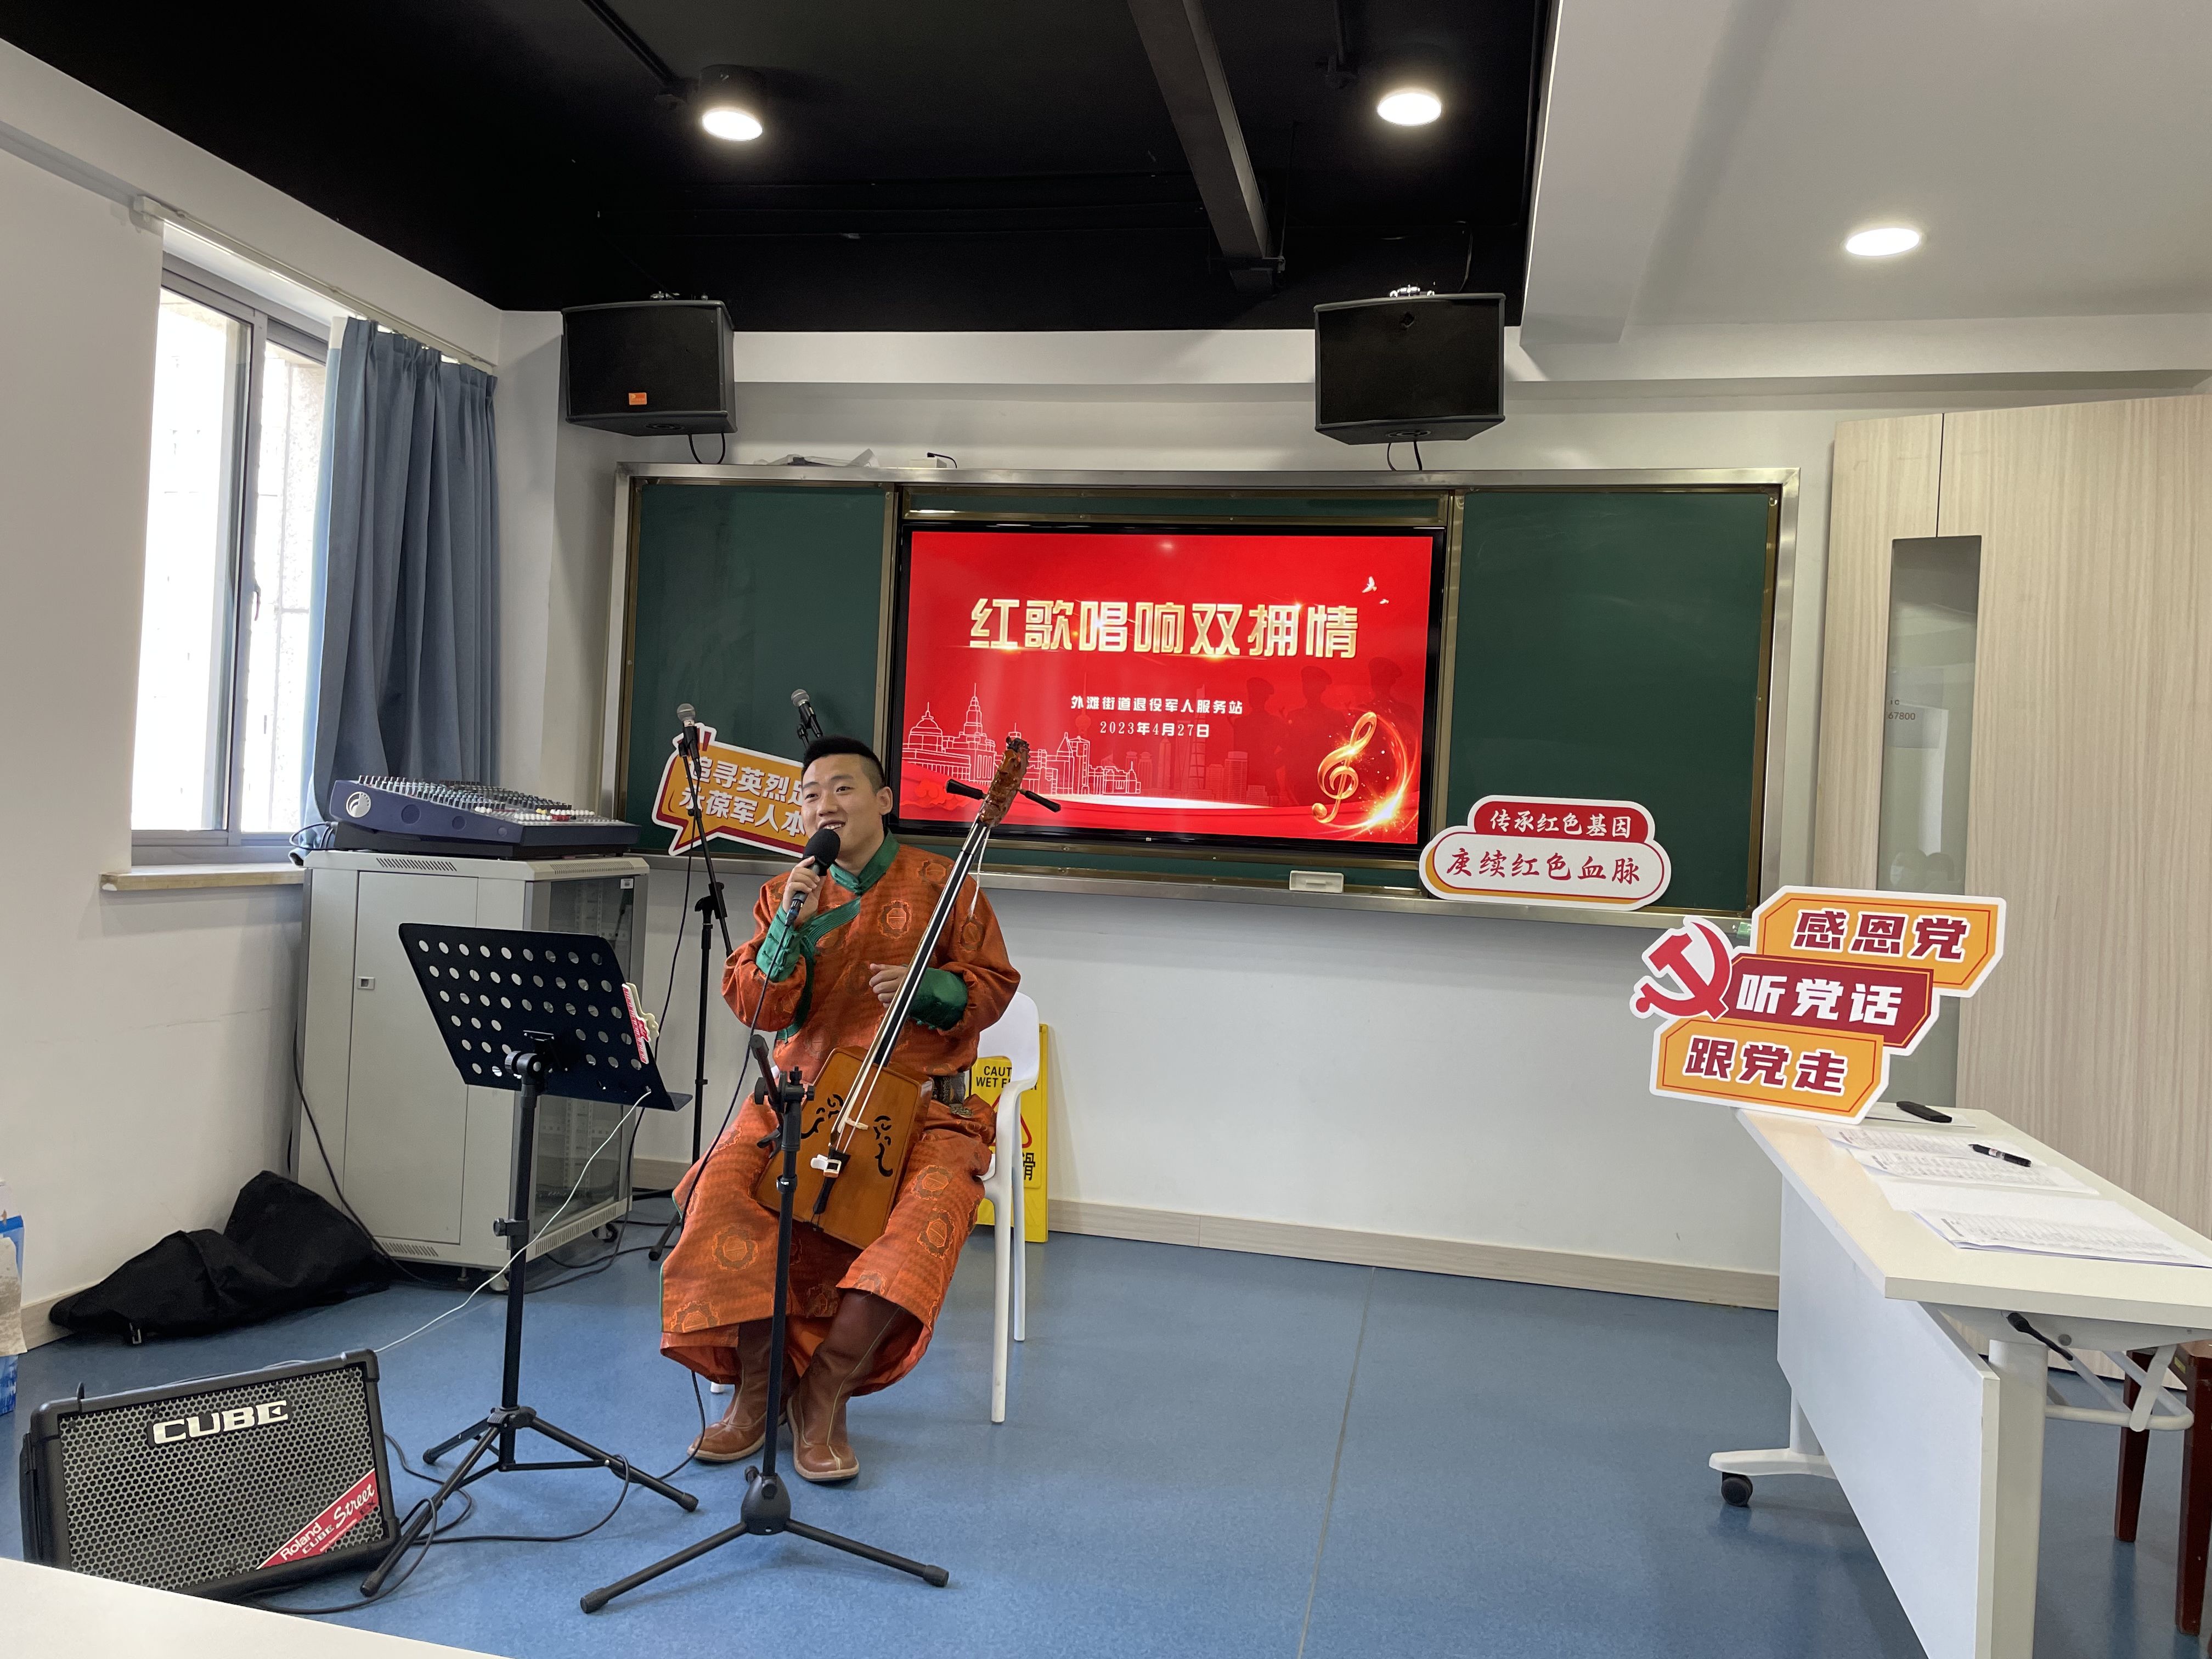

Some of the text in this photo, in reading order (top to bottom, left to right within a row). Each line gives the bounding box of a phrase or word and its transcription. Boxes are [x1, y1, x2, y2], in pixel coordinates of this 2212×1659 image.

[969, 597, 1359, 658] 红歌唱响双拥情
[1071, 695, 1243, 715] 外滩街道退役军人服务站
[1100, 720, 1210, 737] 2023年4月27日
[686, 756, 804, 807] 追寻英烈足
[679, 785, 806, 837] 永葆军人本
[1489, 809, 1632, 839] 传承红色基因
[1446, 848, 1640, 885] 庚续红色血脉
[1791, 910, 1970, 961] 感恩党
[1736, 974, 1903, 1026] 听党话
[976, 1077, 998, 1088] WET
[984, 1065, 1012, 1077] CAUT
[1684, 1036, 1849, 1094] 跟党走
[153, 1400, 288, 1445] CUBE
[280, 1521, 323, 1561] Roland
[302, 1523, 335, 1555] CUBE
[334, 1483, 375, 1529] Street
